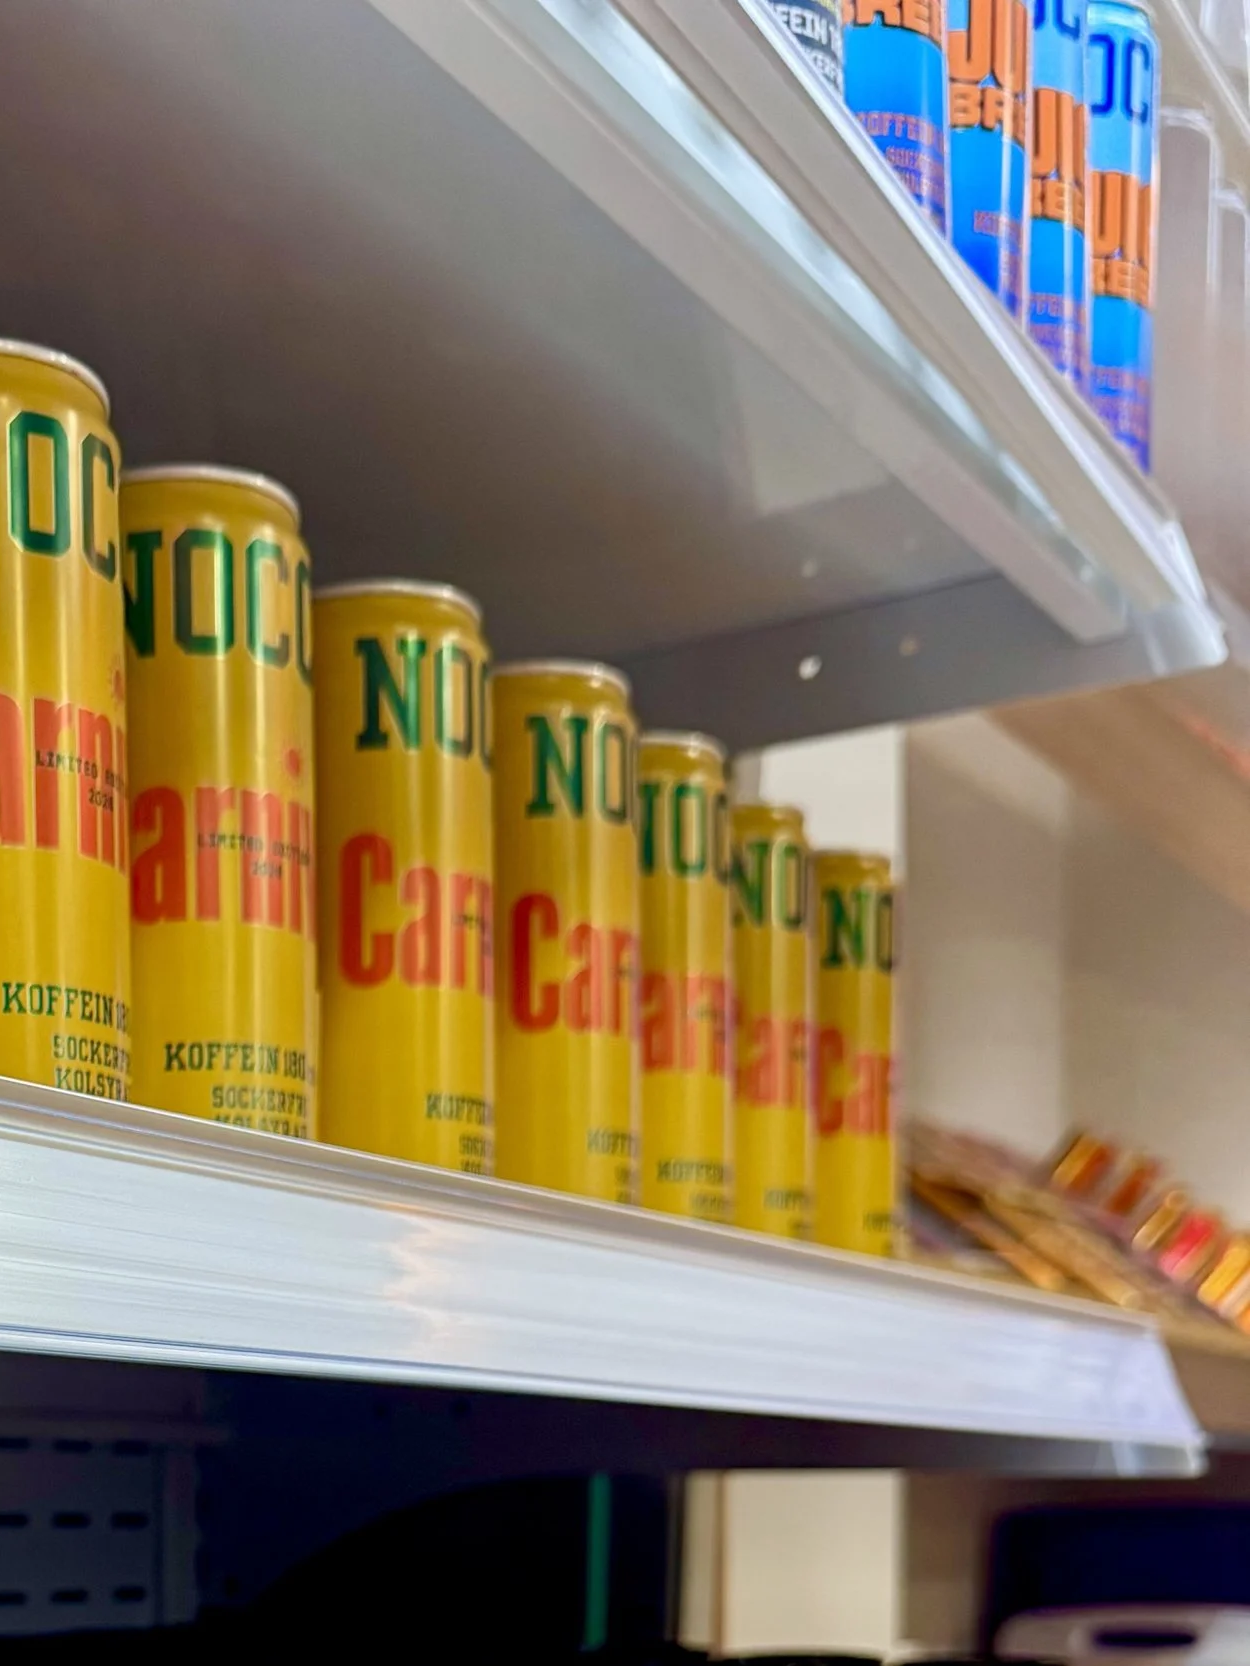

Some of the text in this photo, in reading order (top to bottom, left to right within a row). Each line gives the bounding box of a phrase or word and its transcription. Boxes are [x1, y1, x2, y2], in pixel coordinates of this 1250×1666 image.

[35, 750, 98, 780] LIMITED
[525, 714, 638, 832] NO
[2, 981, 114, 1029] KOFFEIN
[164, 1041, 278, 1076] KOFFEIN
